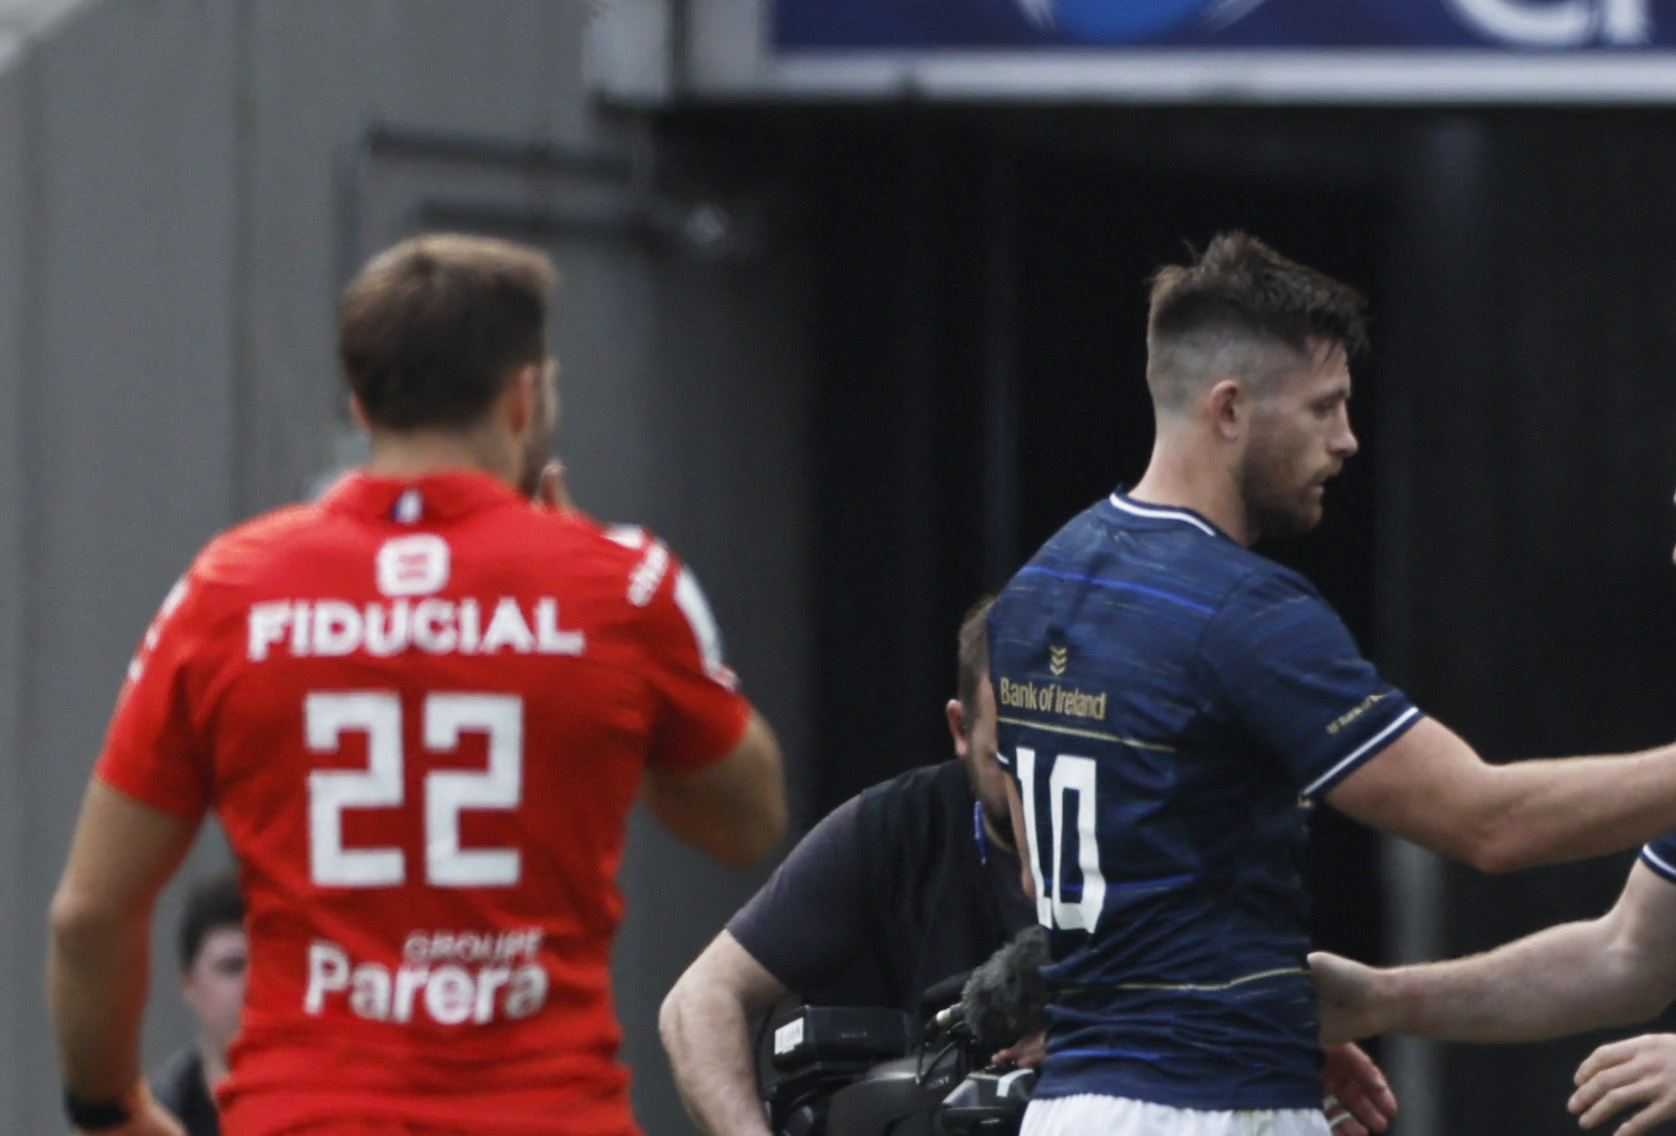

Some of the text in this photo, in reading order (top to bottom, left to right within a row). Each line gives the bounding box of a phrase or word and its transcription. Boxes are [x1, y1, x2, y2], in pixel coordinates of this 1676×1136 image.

[247, 597, 586, 662] FIDUCIAL
[1000, 676, 1108, 721] Bank of Ireland
[305, 692, 524, 887] 22
[1016, 746, 1107, 934] 10
[303, 937, 550, 1026] Parera
[404, 928, 543, 961] GROUPE
